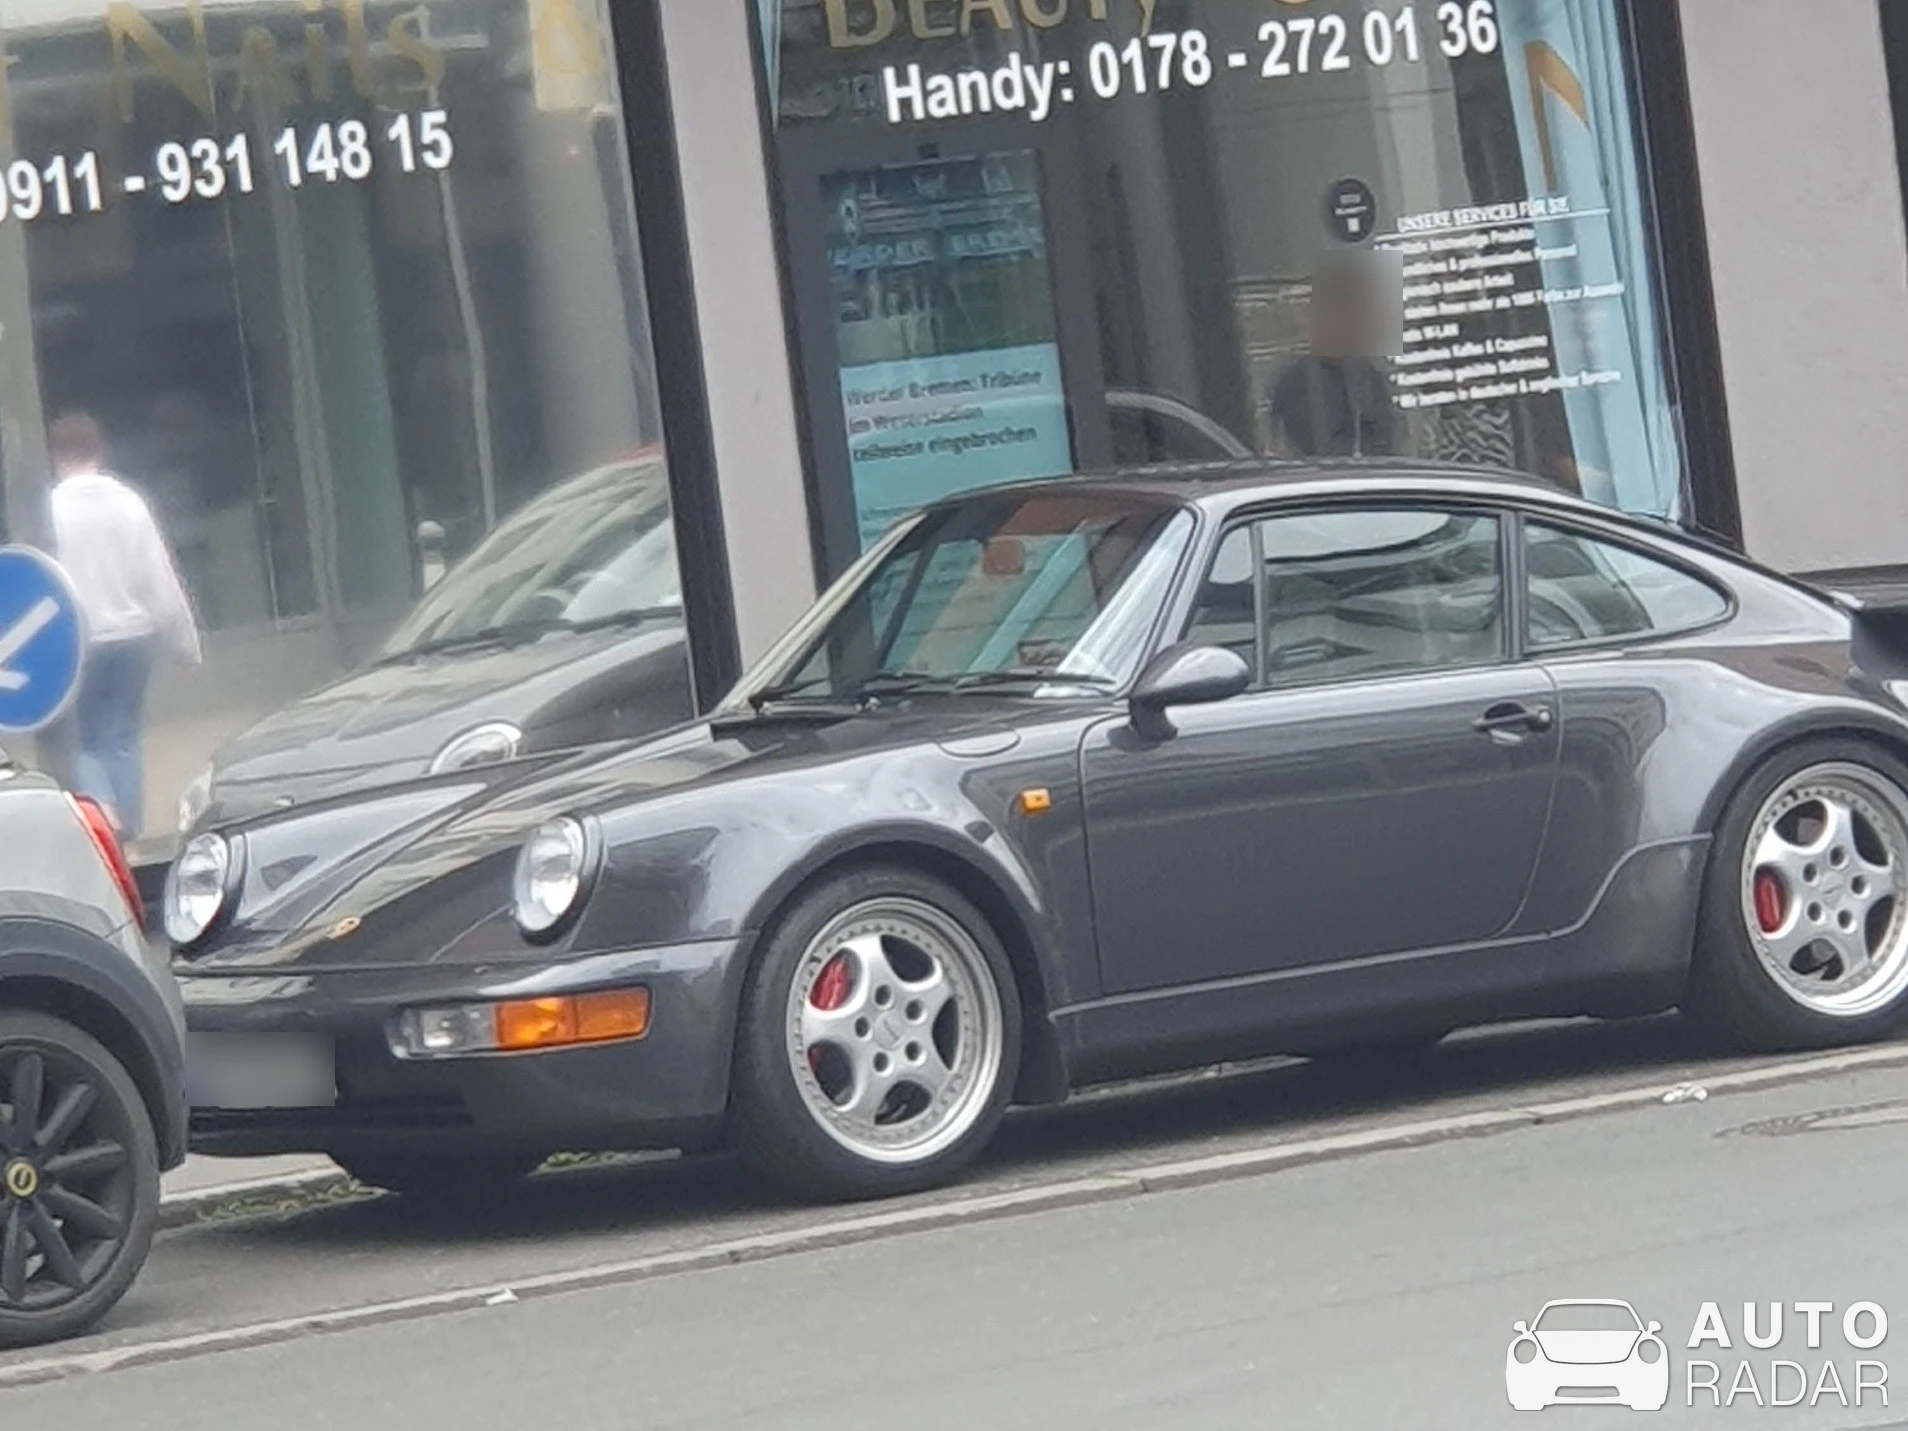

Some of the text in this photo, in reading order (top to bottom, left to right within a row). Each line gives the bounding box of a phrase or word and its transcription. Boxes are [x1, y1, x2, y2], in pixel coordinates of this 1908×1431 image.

[883, 0, 1499, 122] Handy: 0178 - 272 01 36
[124, 175, 146, 190] -
[157, 136, 253, 202] 931
[274, 120, 373, 182] 148
[387, 110, 454, 172] 15
